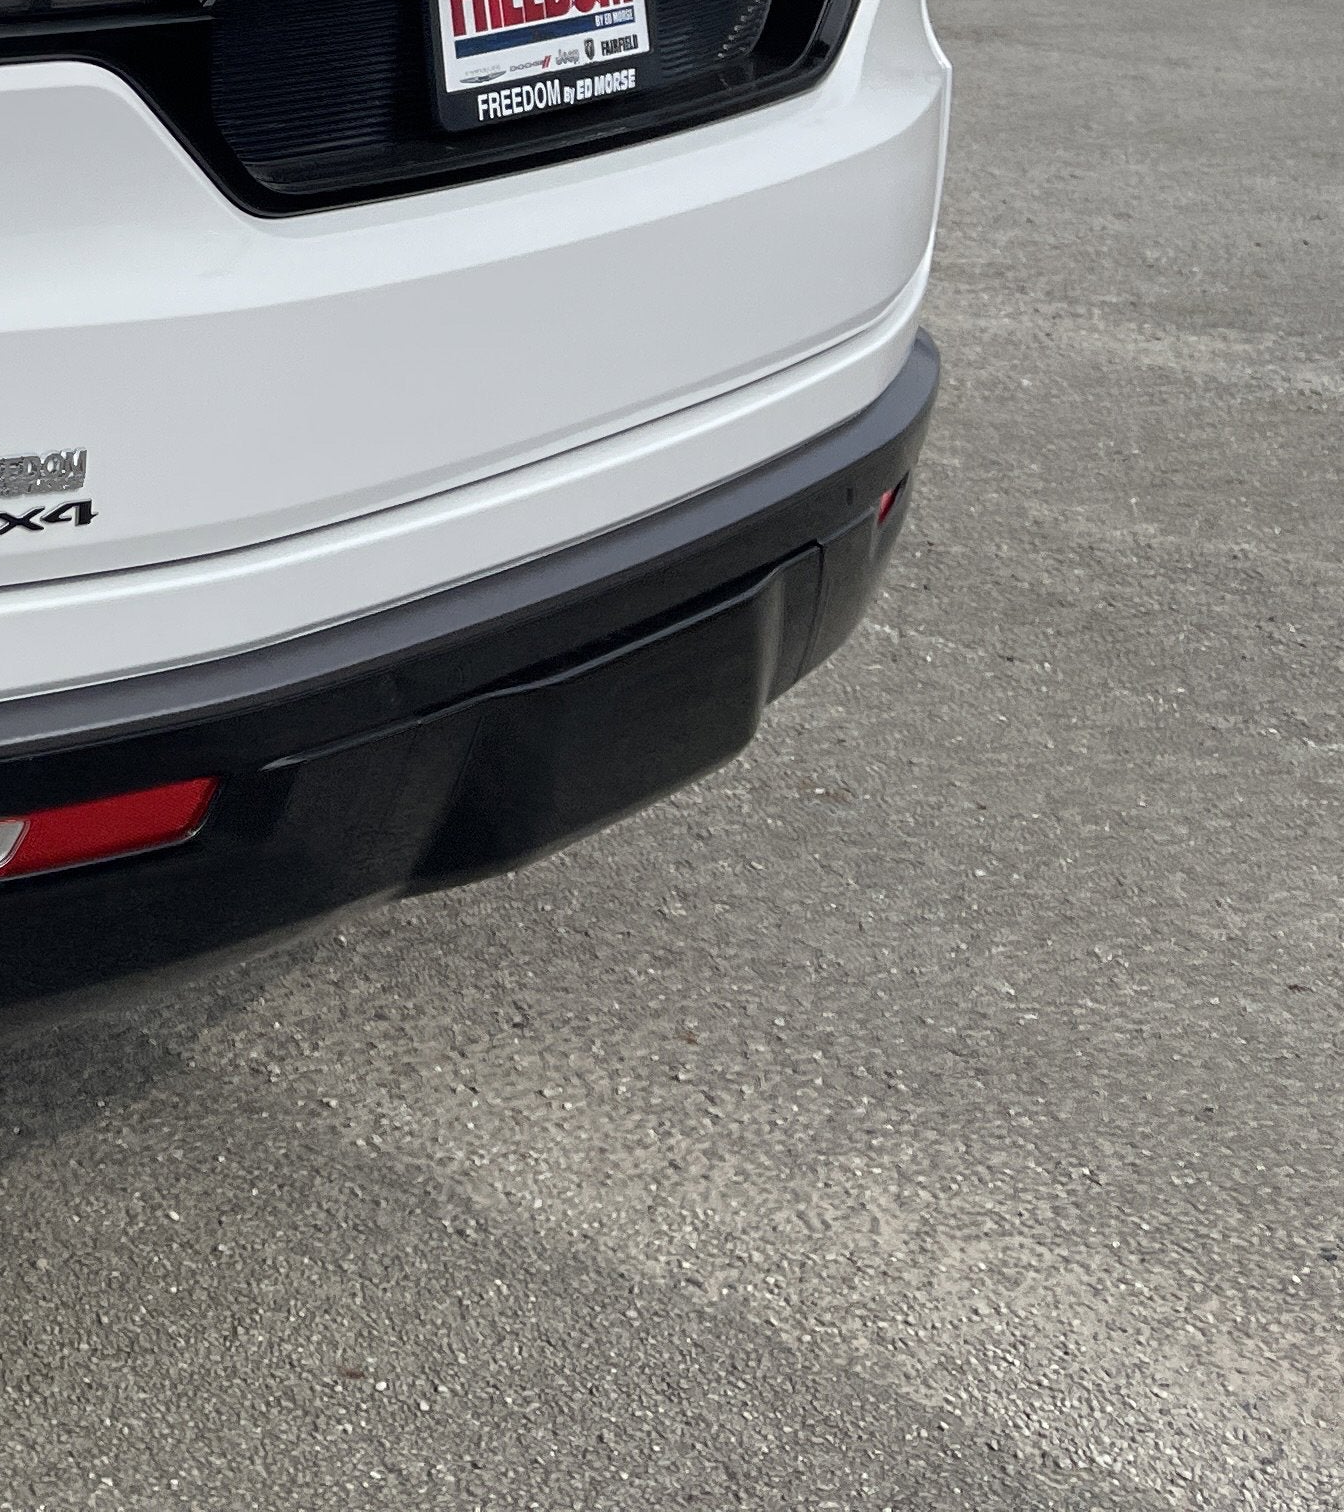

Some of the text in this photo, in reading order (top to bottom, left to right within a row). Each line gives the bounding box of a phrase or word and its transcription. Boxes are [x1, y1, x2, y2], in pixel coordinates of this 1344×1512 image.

[477, 79, 561, 121] FREEDOM
[576, 78, 593, 101] ED
[594, 68, 636, 97] MORSE
